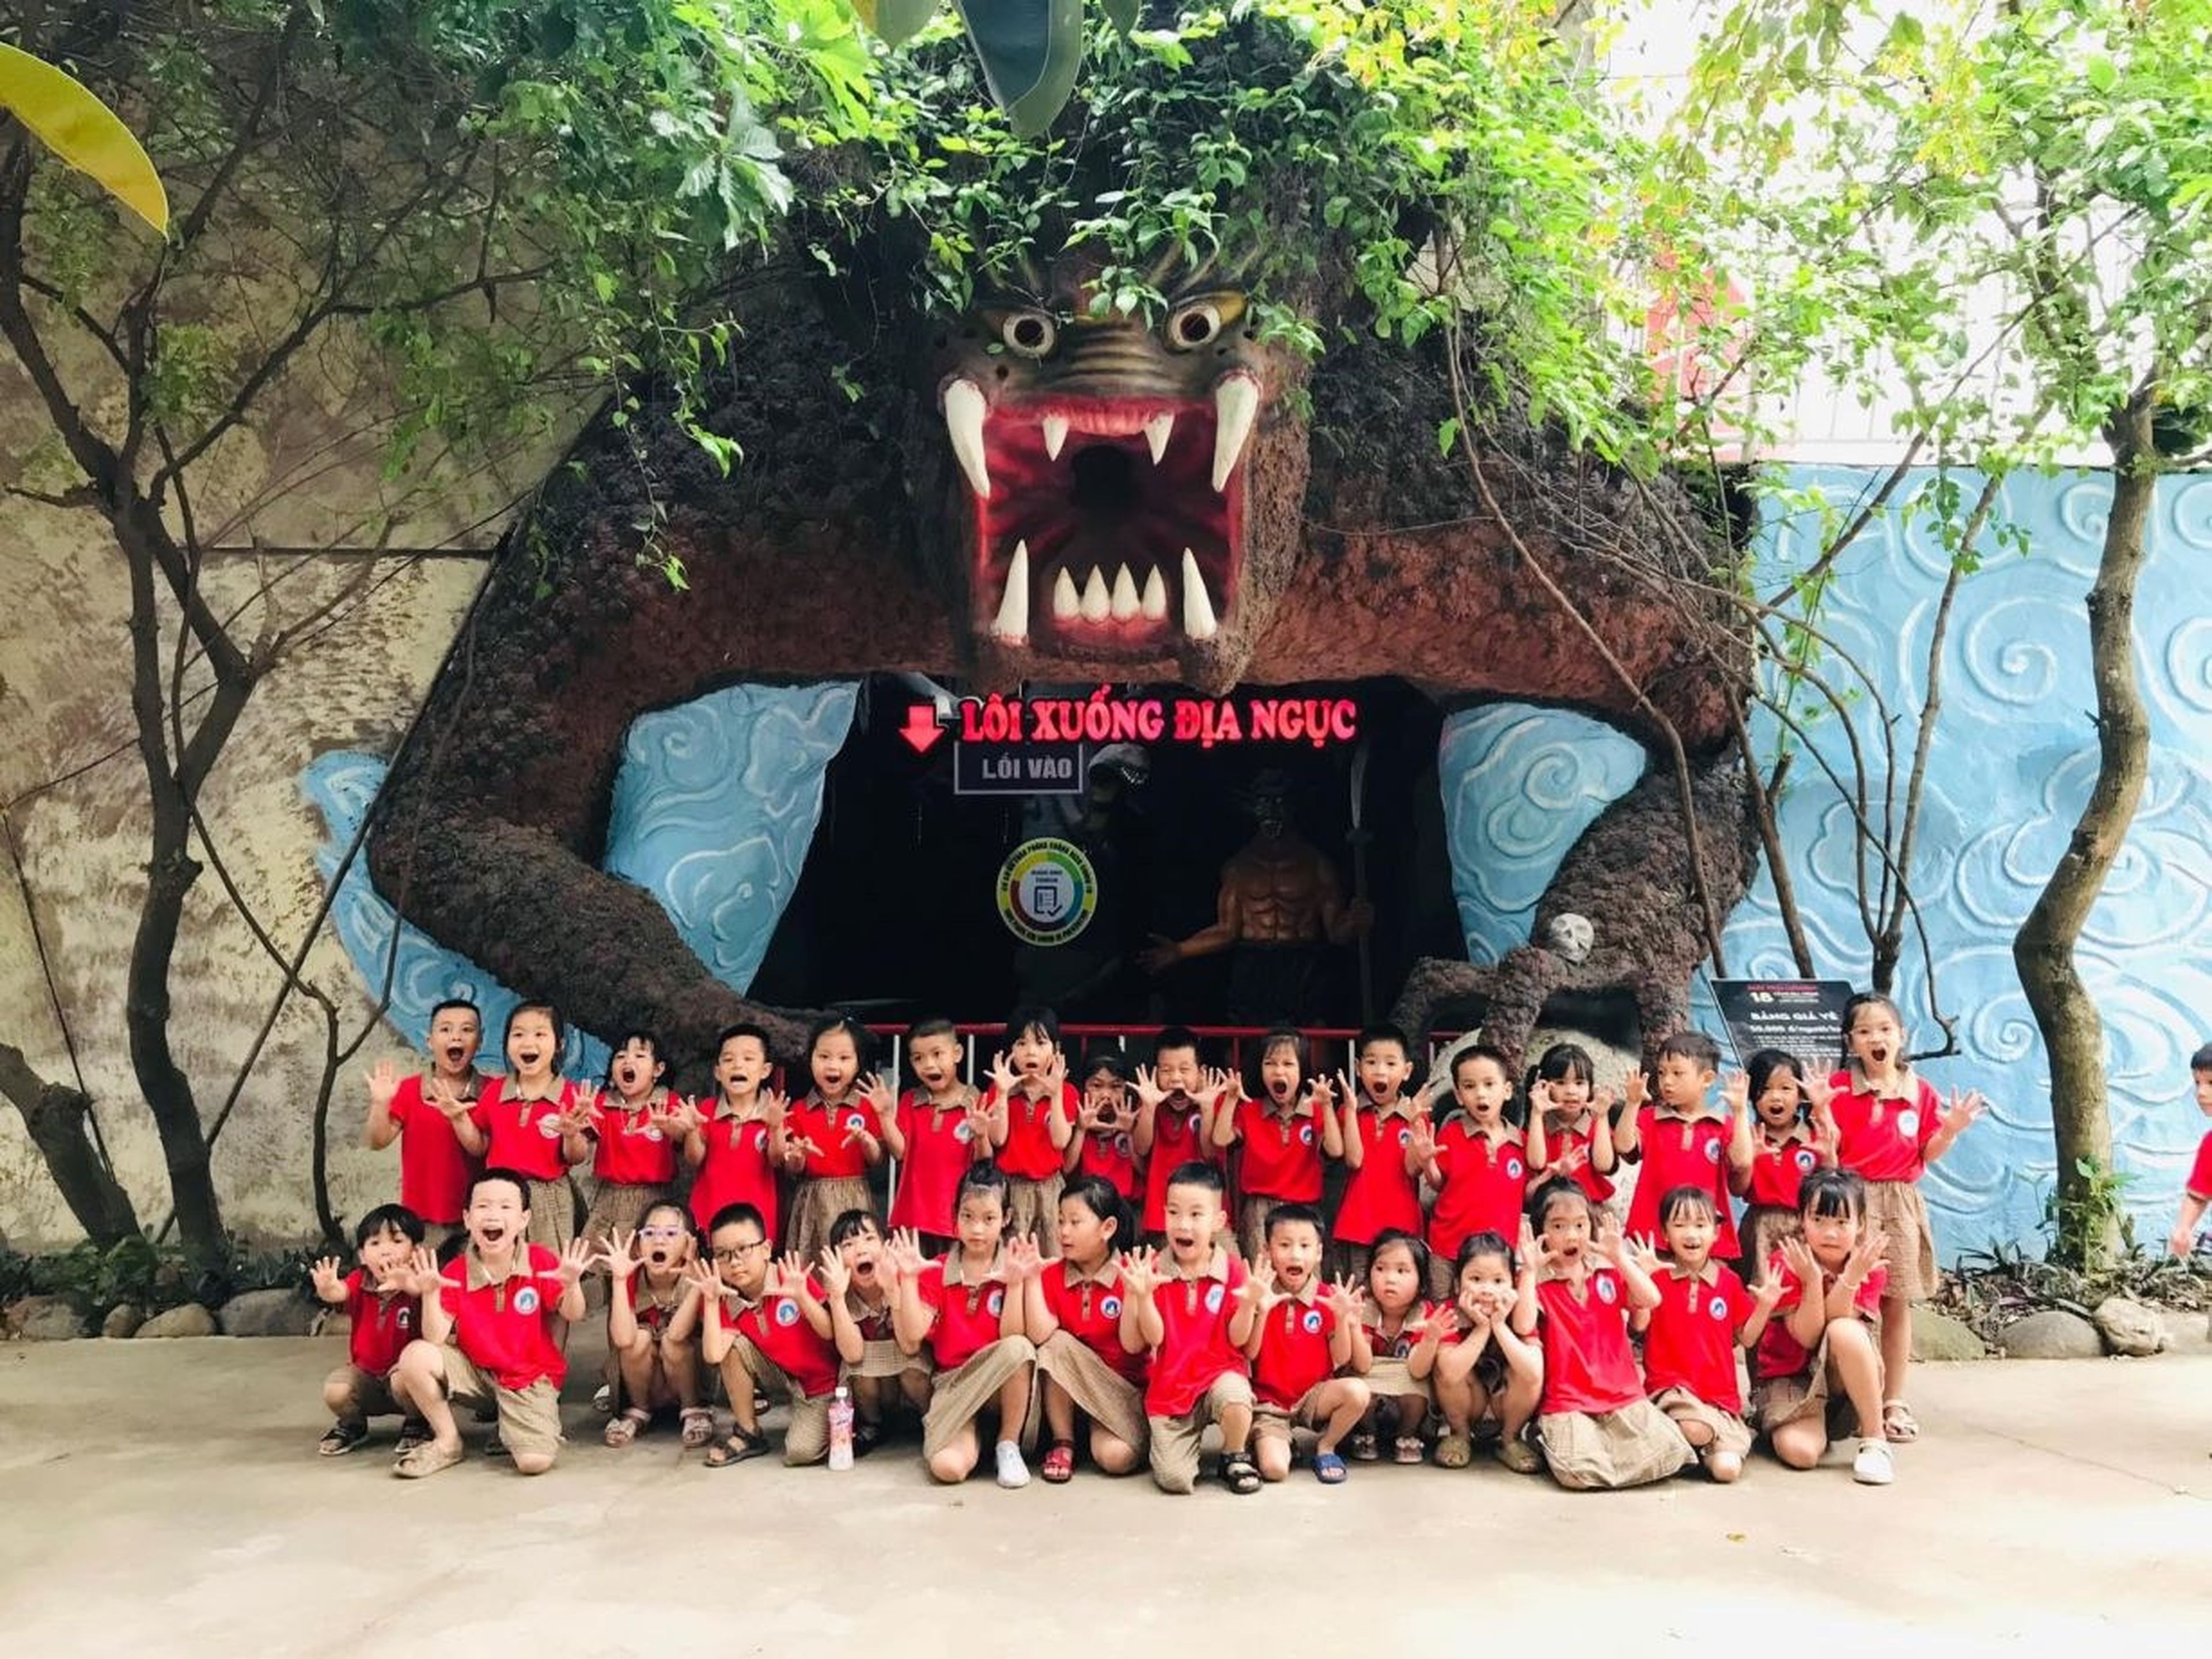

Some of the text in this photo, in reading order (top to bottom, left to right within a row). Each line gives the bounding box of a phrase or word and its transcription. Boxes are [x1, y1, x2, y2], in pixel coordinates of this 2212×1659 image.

[1031, 684, 1165, 741] XUỐNG
[1173, 699, 1242, 748] ĐỊA
[1249, 699, 1357, 748] NGỤC
[1028, 756, 1073, 779] VÀO
